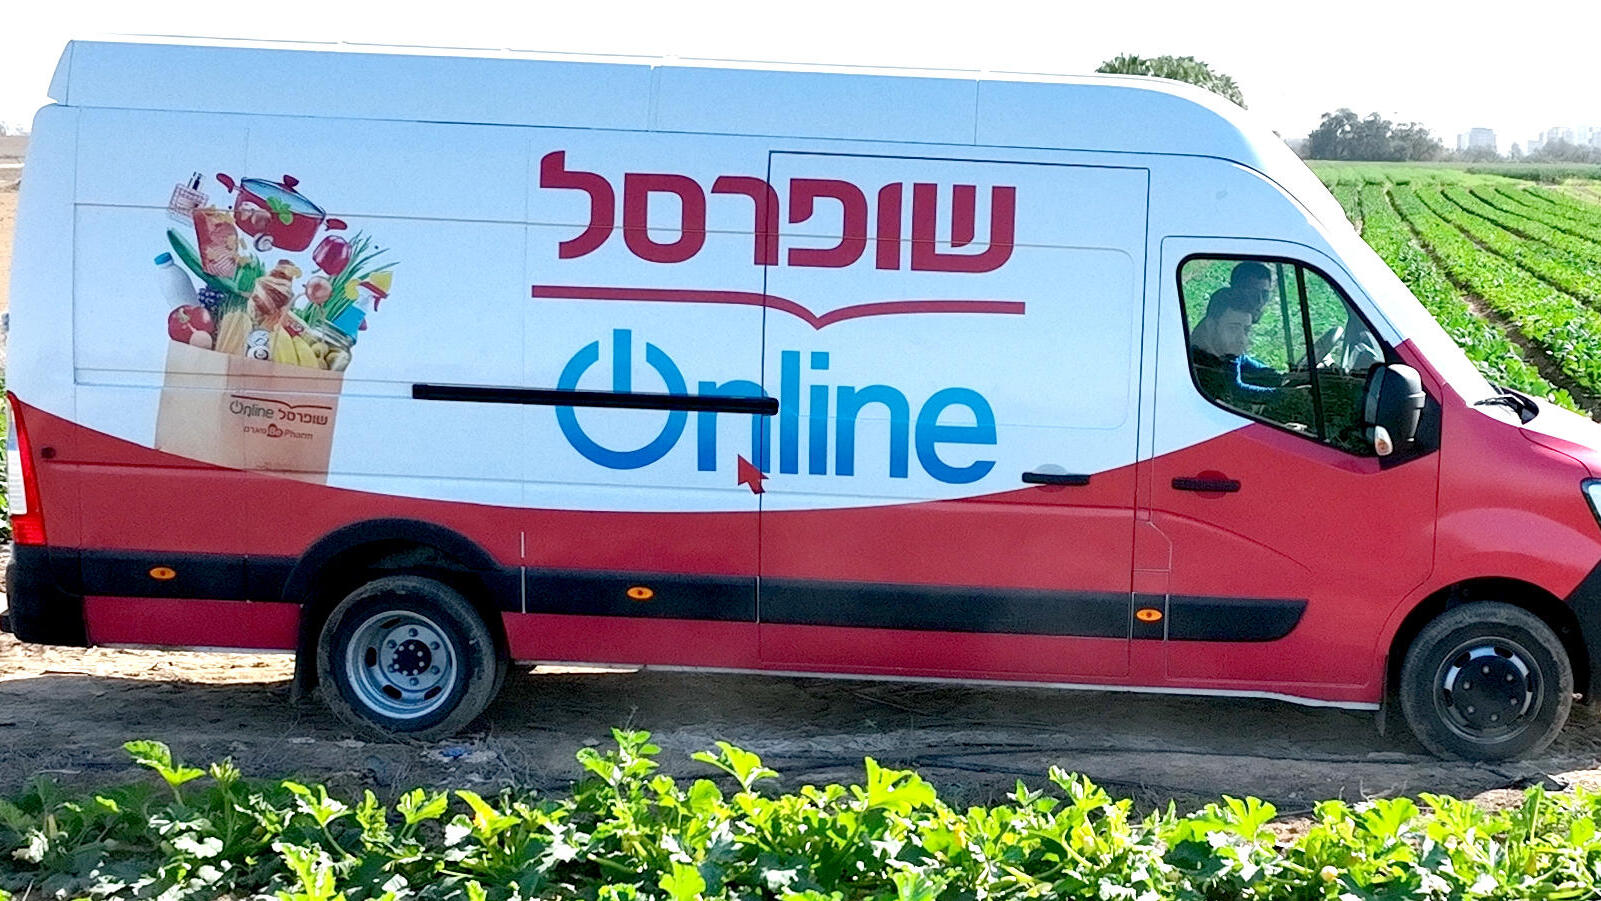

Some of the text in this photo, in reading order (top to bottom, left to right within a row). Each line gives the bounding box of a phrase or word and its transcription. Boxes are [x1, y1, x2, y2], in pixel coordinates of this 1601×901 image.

[540, 150, 1016, 272] שופרסל
[229, 400, 328, 425] שופרסל Online
[555, 328, 998, 485] Online
